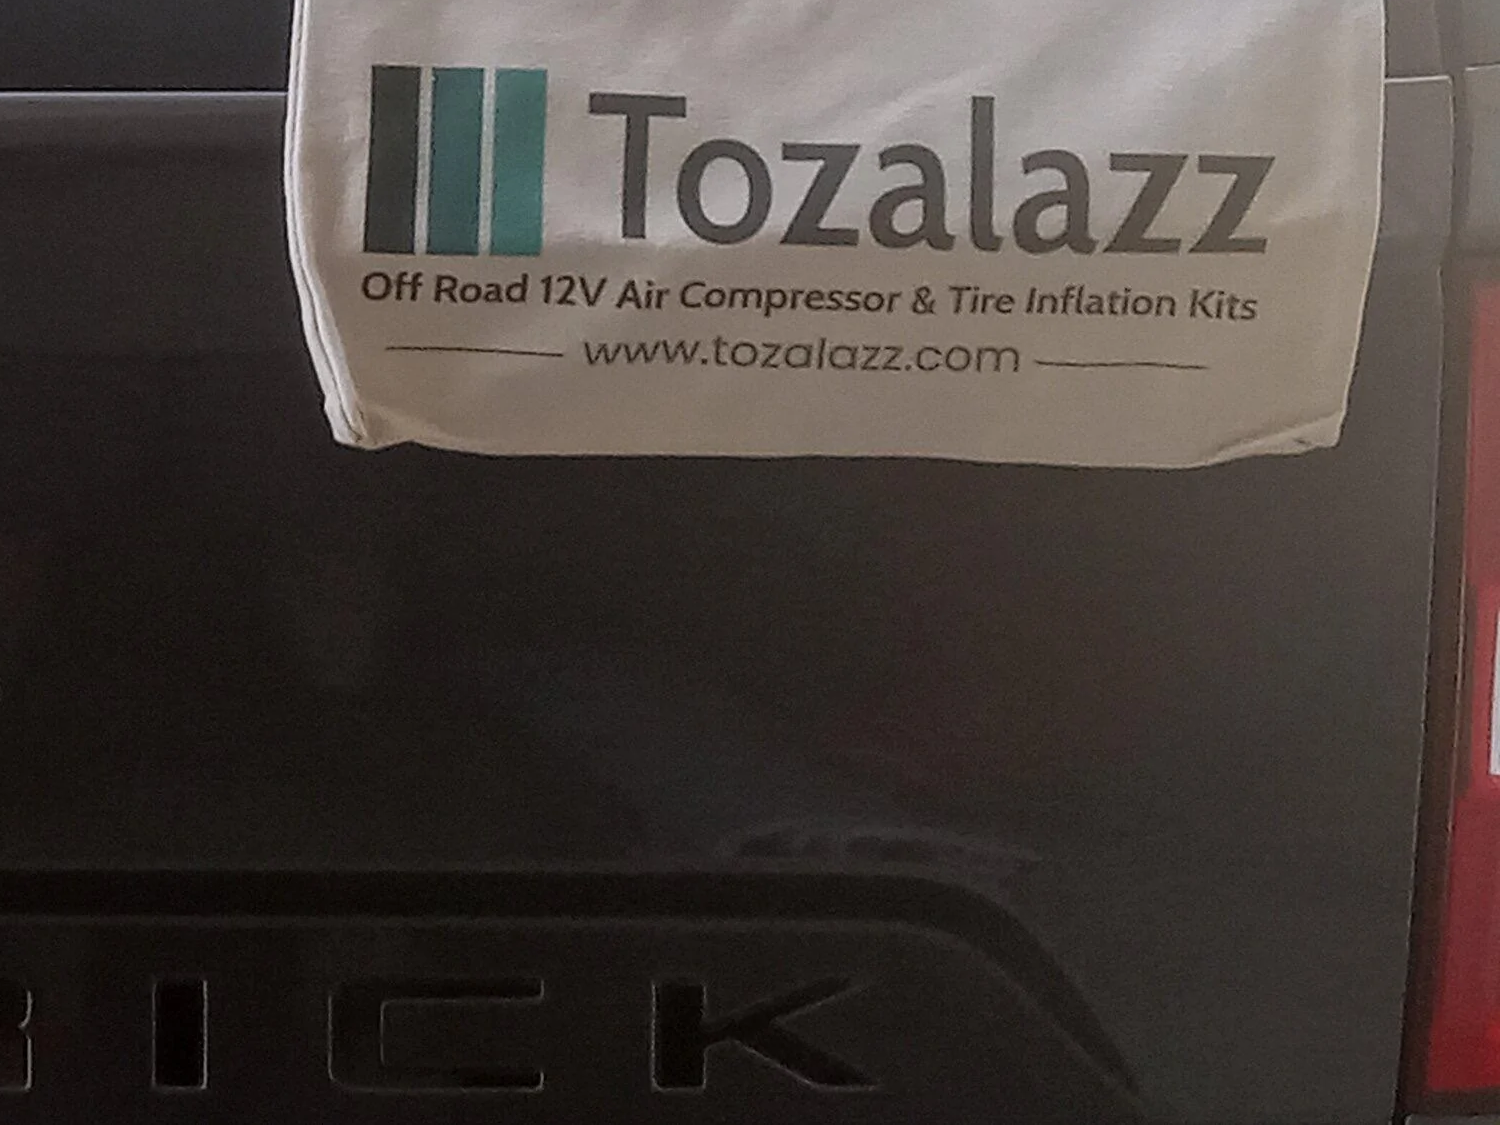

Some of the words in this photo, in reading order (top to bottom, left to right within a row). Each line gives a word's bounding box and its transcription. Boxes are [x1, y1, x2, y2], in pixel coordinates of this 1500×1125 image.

[587, 91, 1278, 256] Tozalazz
[361, 271, 423, 303] Off
[433, 272, 529, 305] Road
[540, 274, 608, 308] 12V
[615, 279, 671, 311] Air
[679, 281, 902, 319] Compressor
[910, 285, 937, 316] &
[948, 284, 1016, 316] Tire
[1025, 284, 1178, 318] Inflation
[1188, 288, 1259, 322] Kits
[581, 334, 1022, 375] www.tozalazz.com
